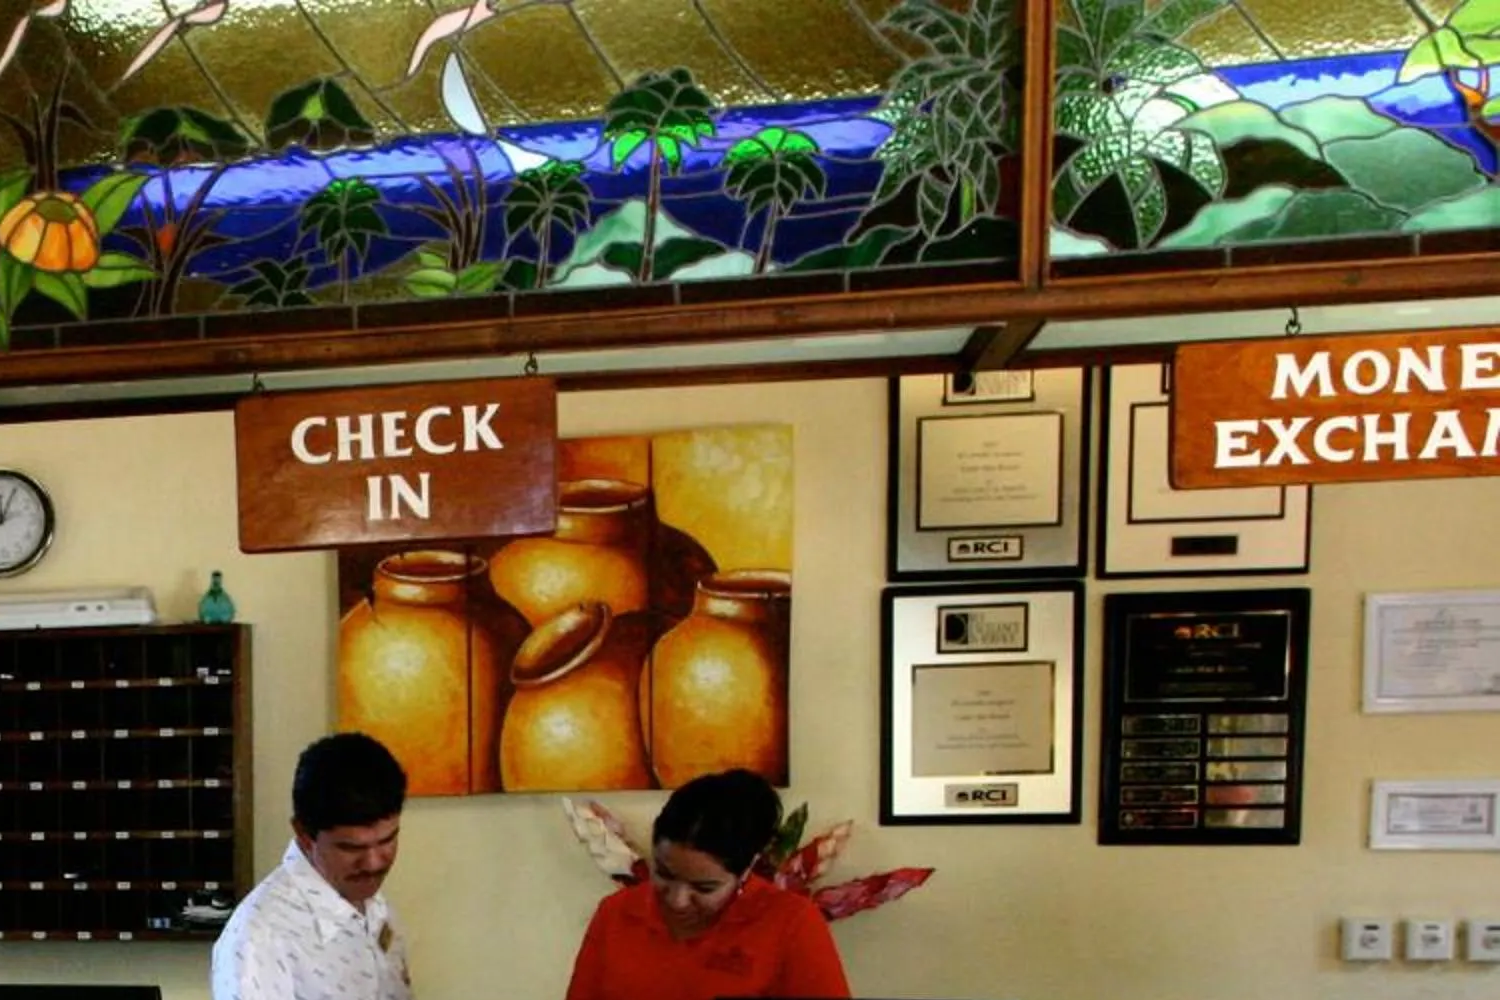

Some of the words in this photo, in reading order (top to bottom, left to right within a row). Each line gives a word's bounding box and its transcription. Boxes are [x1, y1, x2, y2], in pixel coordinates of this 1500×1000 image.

[1270, 342, 1500, 400] MONE
[290, 403, 504, 465] CHECK
[367, 472, 431, 521] IN
[973, 540, 1009, 554] RCI
[972, 789, 1008, 802] RCI
